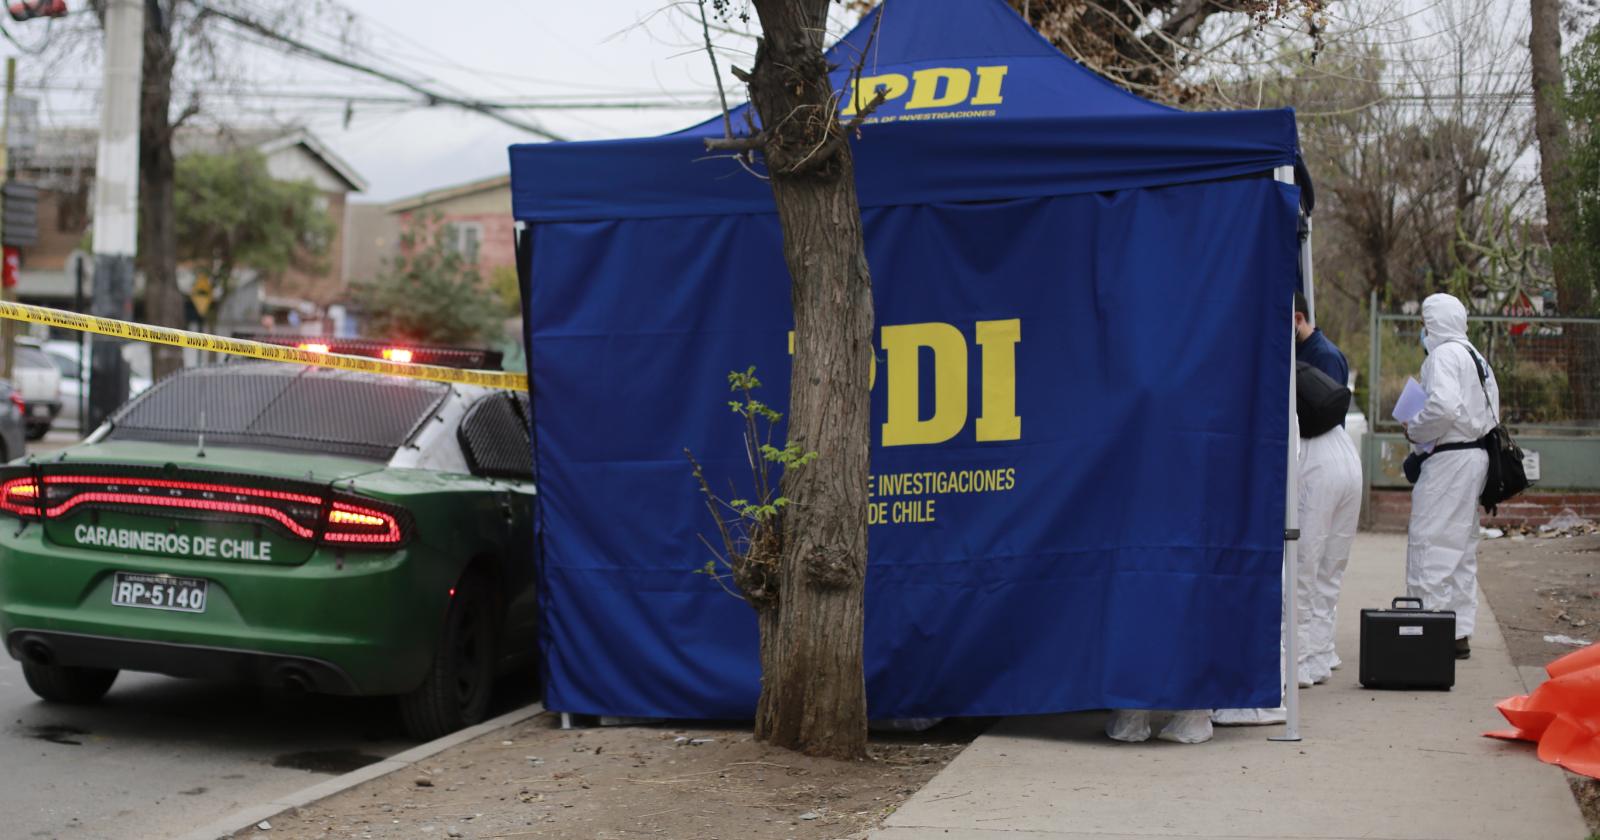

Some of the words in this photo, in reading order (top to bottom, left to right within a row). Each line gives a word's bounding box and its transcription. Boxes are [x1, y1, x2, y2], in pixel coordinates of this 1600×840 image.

[841, 65, 1008, 116] PDI
[898, 109, 997, 122] INVESTIGACIONES
[788, 318, 1021, 447] DI
[878, 467, 1016, 497] INVESTIGACIONES
[868, 502, 888, 525] DE
[892, 500, 936, 524] CHILE
[74, 523, 190, 555] CARABINEROS
[193, 536, 217, 558] DE
[220, 538, 272, 561] CHILE
